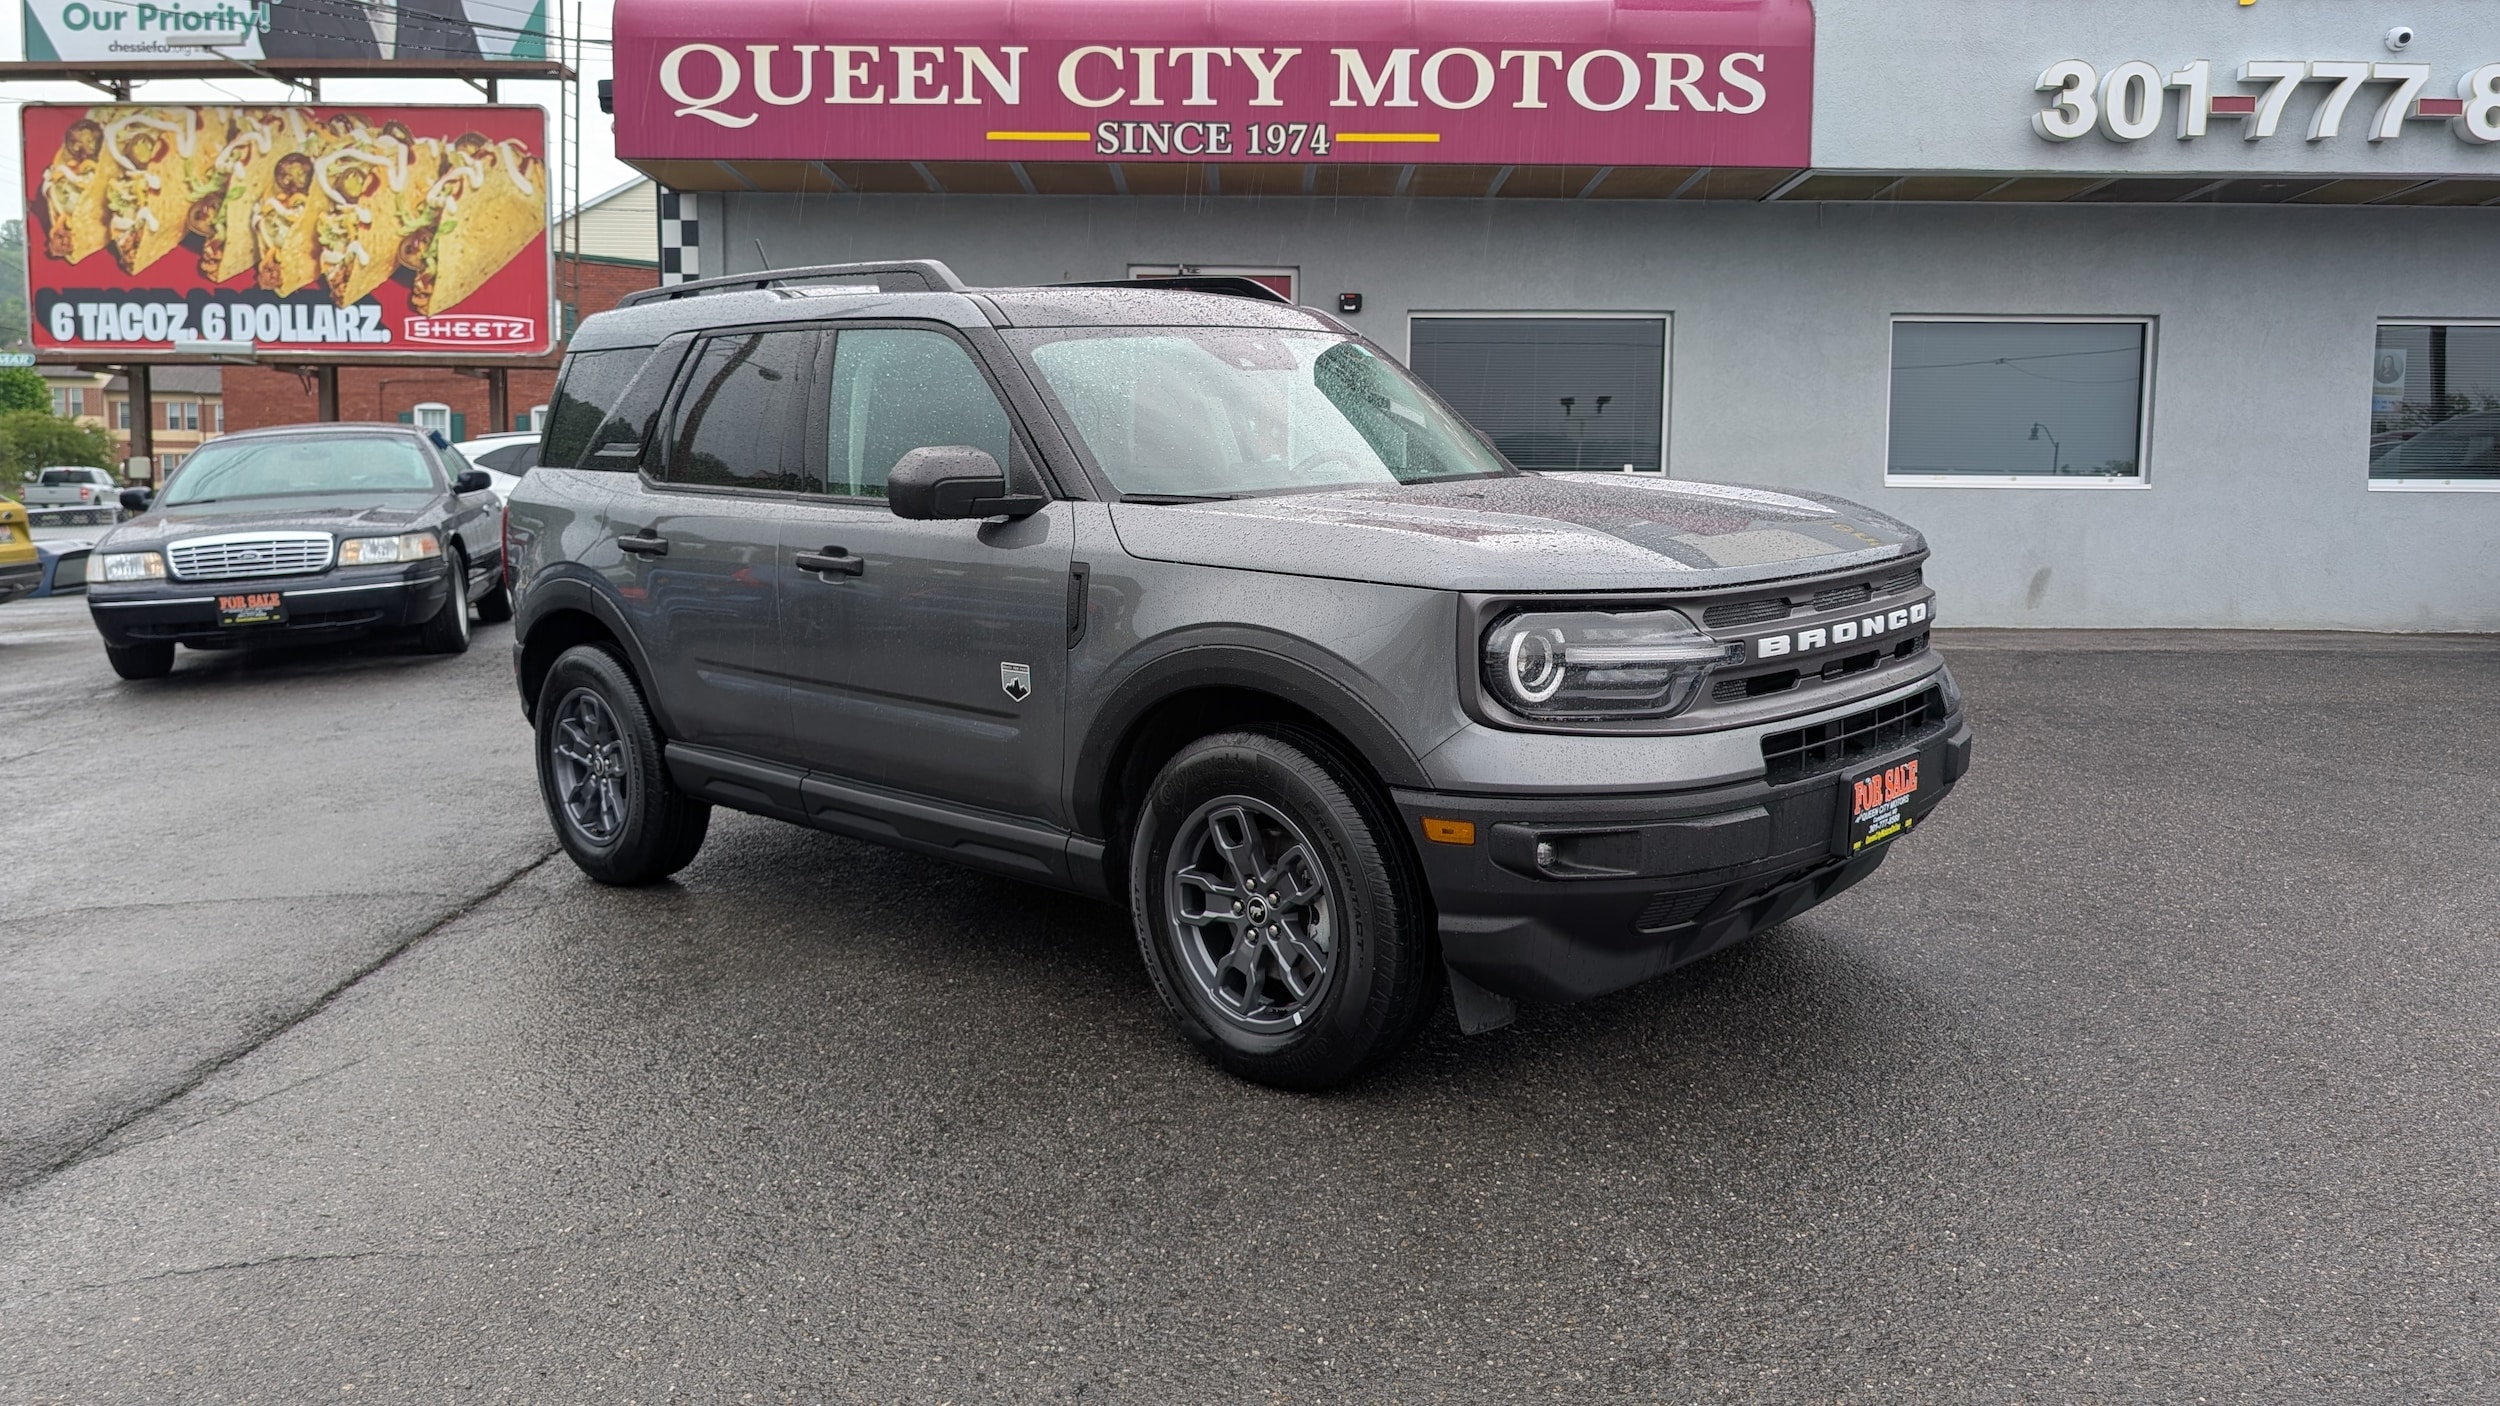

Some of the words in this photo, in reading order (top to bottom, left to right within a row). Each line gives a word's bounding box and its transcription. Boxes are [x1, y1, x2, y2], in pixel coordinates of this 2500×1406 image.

[63, 2, 127, 31] Our
[139, 1, 271, 44] Priority!
[659, 43, 1029, 127] QUEEN
[1058, 46, 1302, 108] CITY
[1329, 48, 1767, 114] MOTORS
[1096, 121, 1233, 155] SINCE
[1246, 122, 1331, 155] 1974
[51, 302, 75, 342] 6
[202, 302, 226, 342] 6
[230, 303, 392, 343] DOLLARZ.
[414, 321, 525, 338] SHEETZ
[218, 595, 247, 610] FOR
[247, 593, 280, 607] SALE
[1757, 603, 1926, 658] BRONCO
[1854, 774, 1883, 815] FOR
[1884, 759, 1918, 802] SALE
[1861, 808, 1879, 821] QUEEN
[1879, 803, 1890, 813] CITY
[1890, 794, 1910, 805] MOTORS
